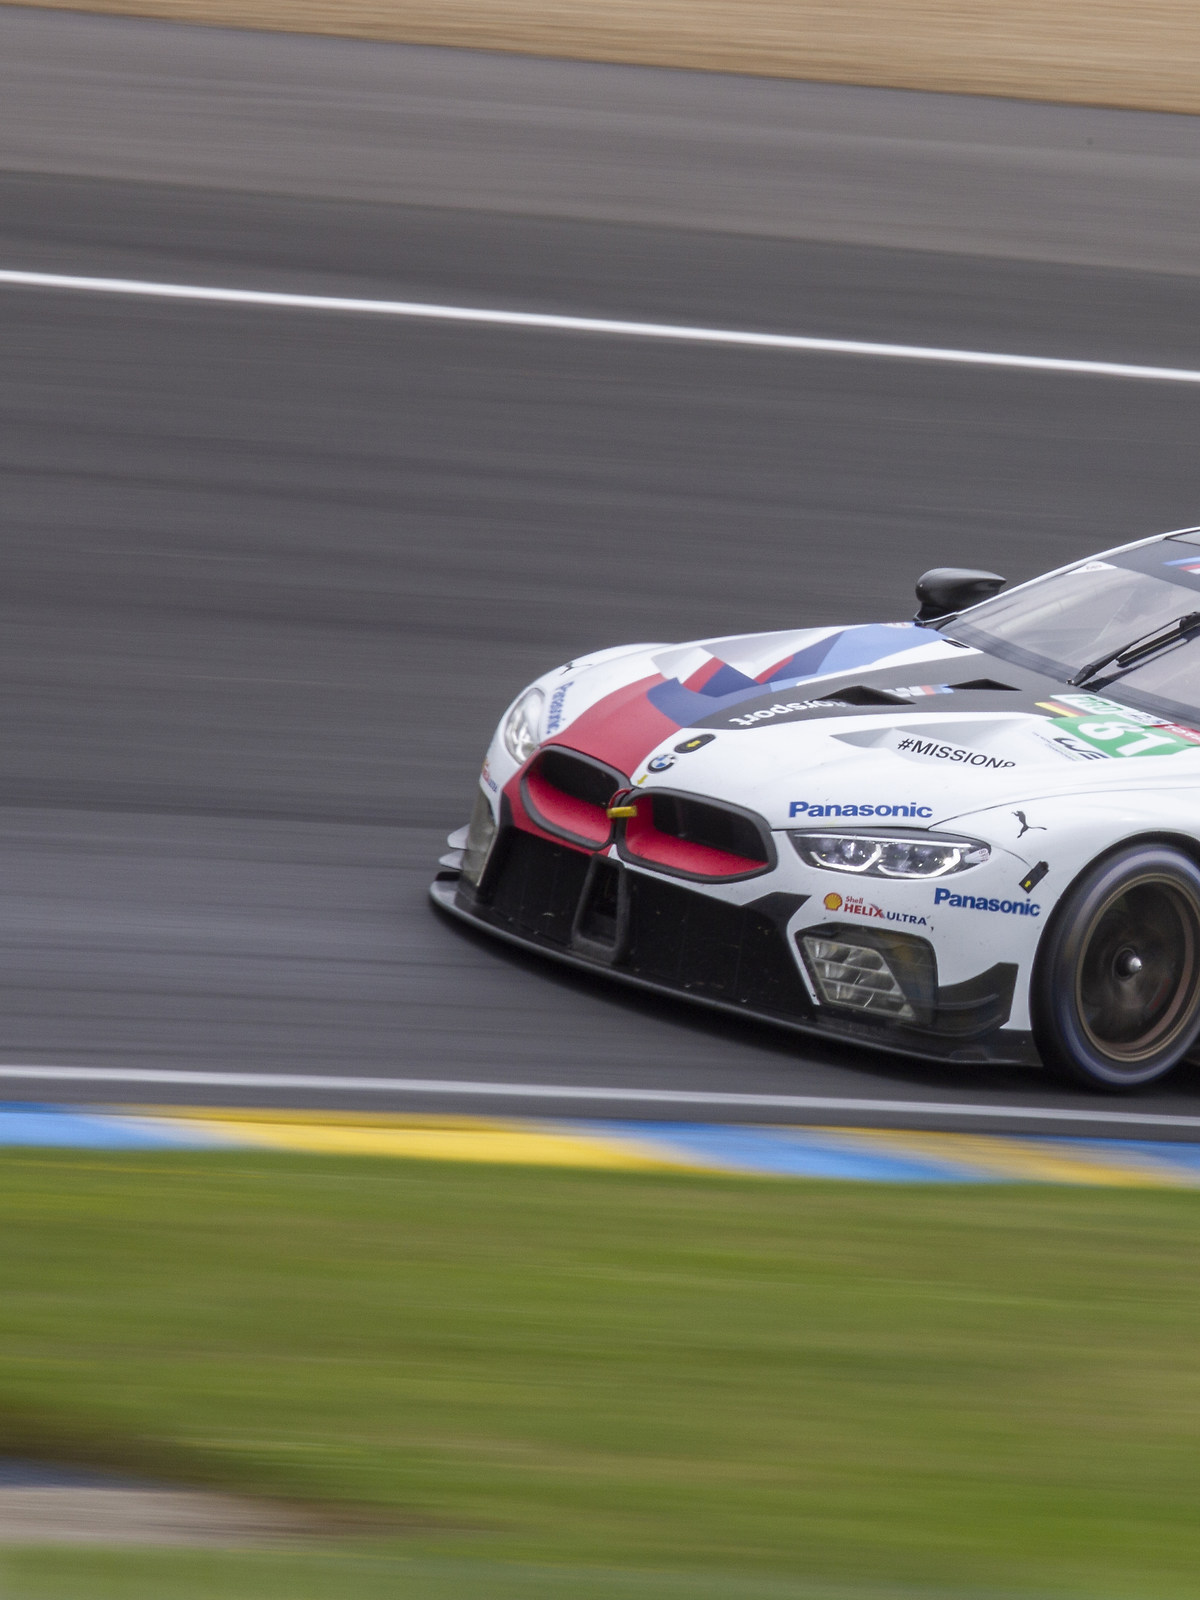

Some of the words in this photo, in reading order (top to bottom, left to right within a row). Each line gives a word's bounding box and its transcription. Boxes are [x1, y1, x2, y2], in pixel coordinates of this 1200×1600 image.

[729, 698, 848, 726] orsport
[789, 801, 933, 818] Panasonic
[845, 895, 864, 904] Shell
[934, 887, 1042, 917] Panasonic
[843, 903, 884, 918] HELIX
[886, 911, 927, 926] ULTRA
